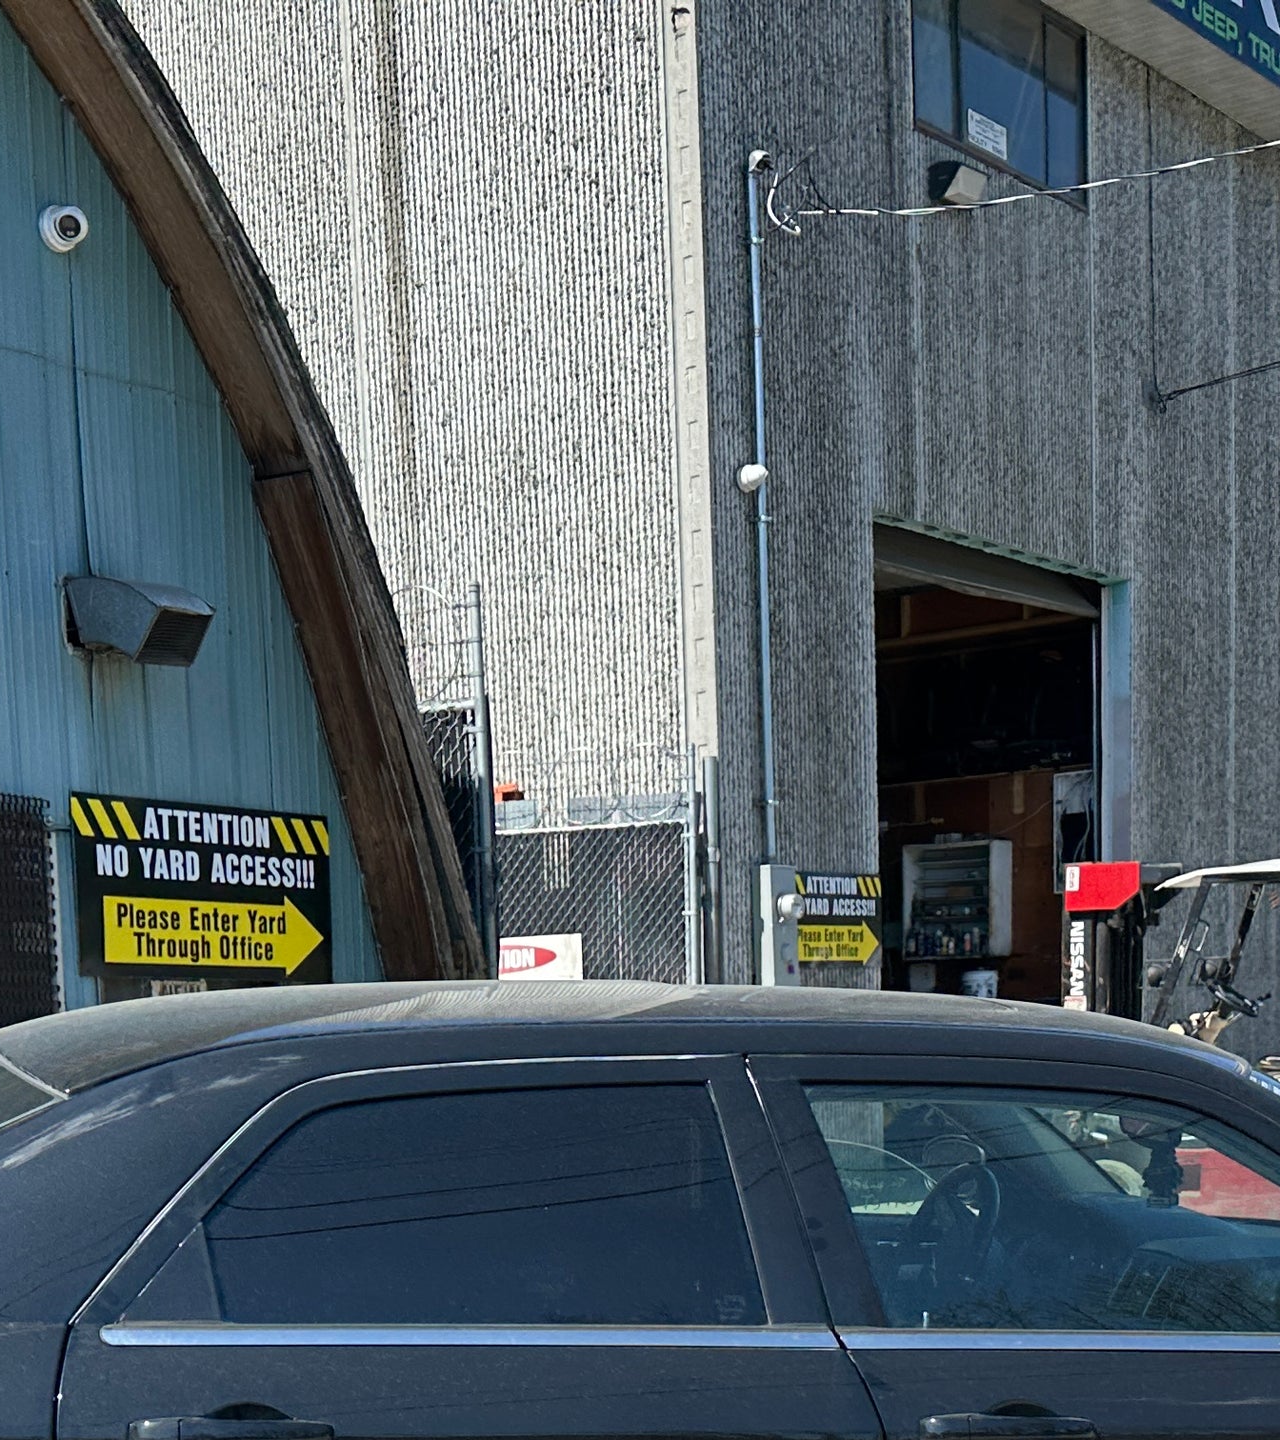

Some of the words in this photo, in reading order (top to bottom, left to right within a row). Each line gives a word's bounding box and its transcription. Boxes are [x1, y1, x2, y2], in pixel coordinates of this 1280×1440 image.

[1191, 3, 1243, 55] JEEP,
[143, 807, 270, 849] ATTENTION
[96, 843, 129, 877] NO
[139, 847, 200, 881] YARD
[211, 852, 315, 889] ACCESS!!!
[806, 876, 857, 895] ATTENTION
[117, 903, 180, 930] Please
[190, 907, 239, 933] Enter
[248, 910, 286, 934] Yard
[805, 898, 829, 915] YARD
[832, 899, 876, 917] ACCESS!!!
[133, 932, 211, 963] Through
[220, 935, 274, 961] Office
[824, 928, 844, 942] Enter
[847, 929, 864, 943] Yard
[803, 944, 833, 959] Through
[836, 945, 859, 957] Office
[1070, 921, 1085, 996] NISSAN
